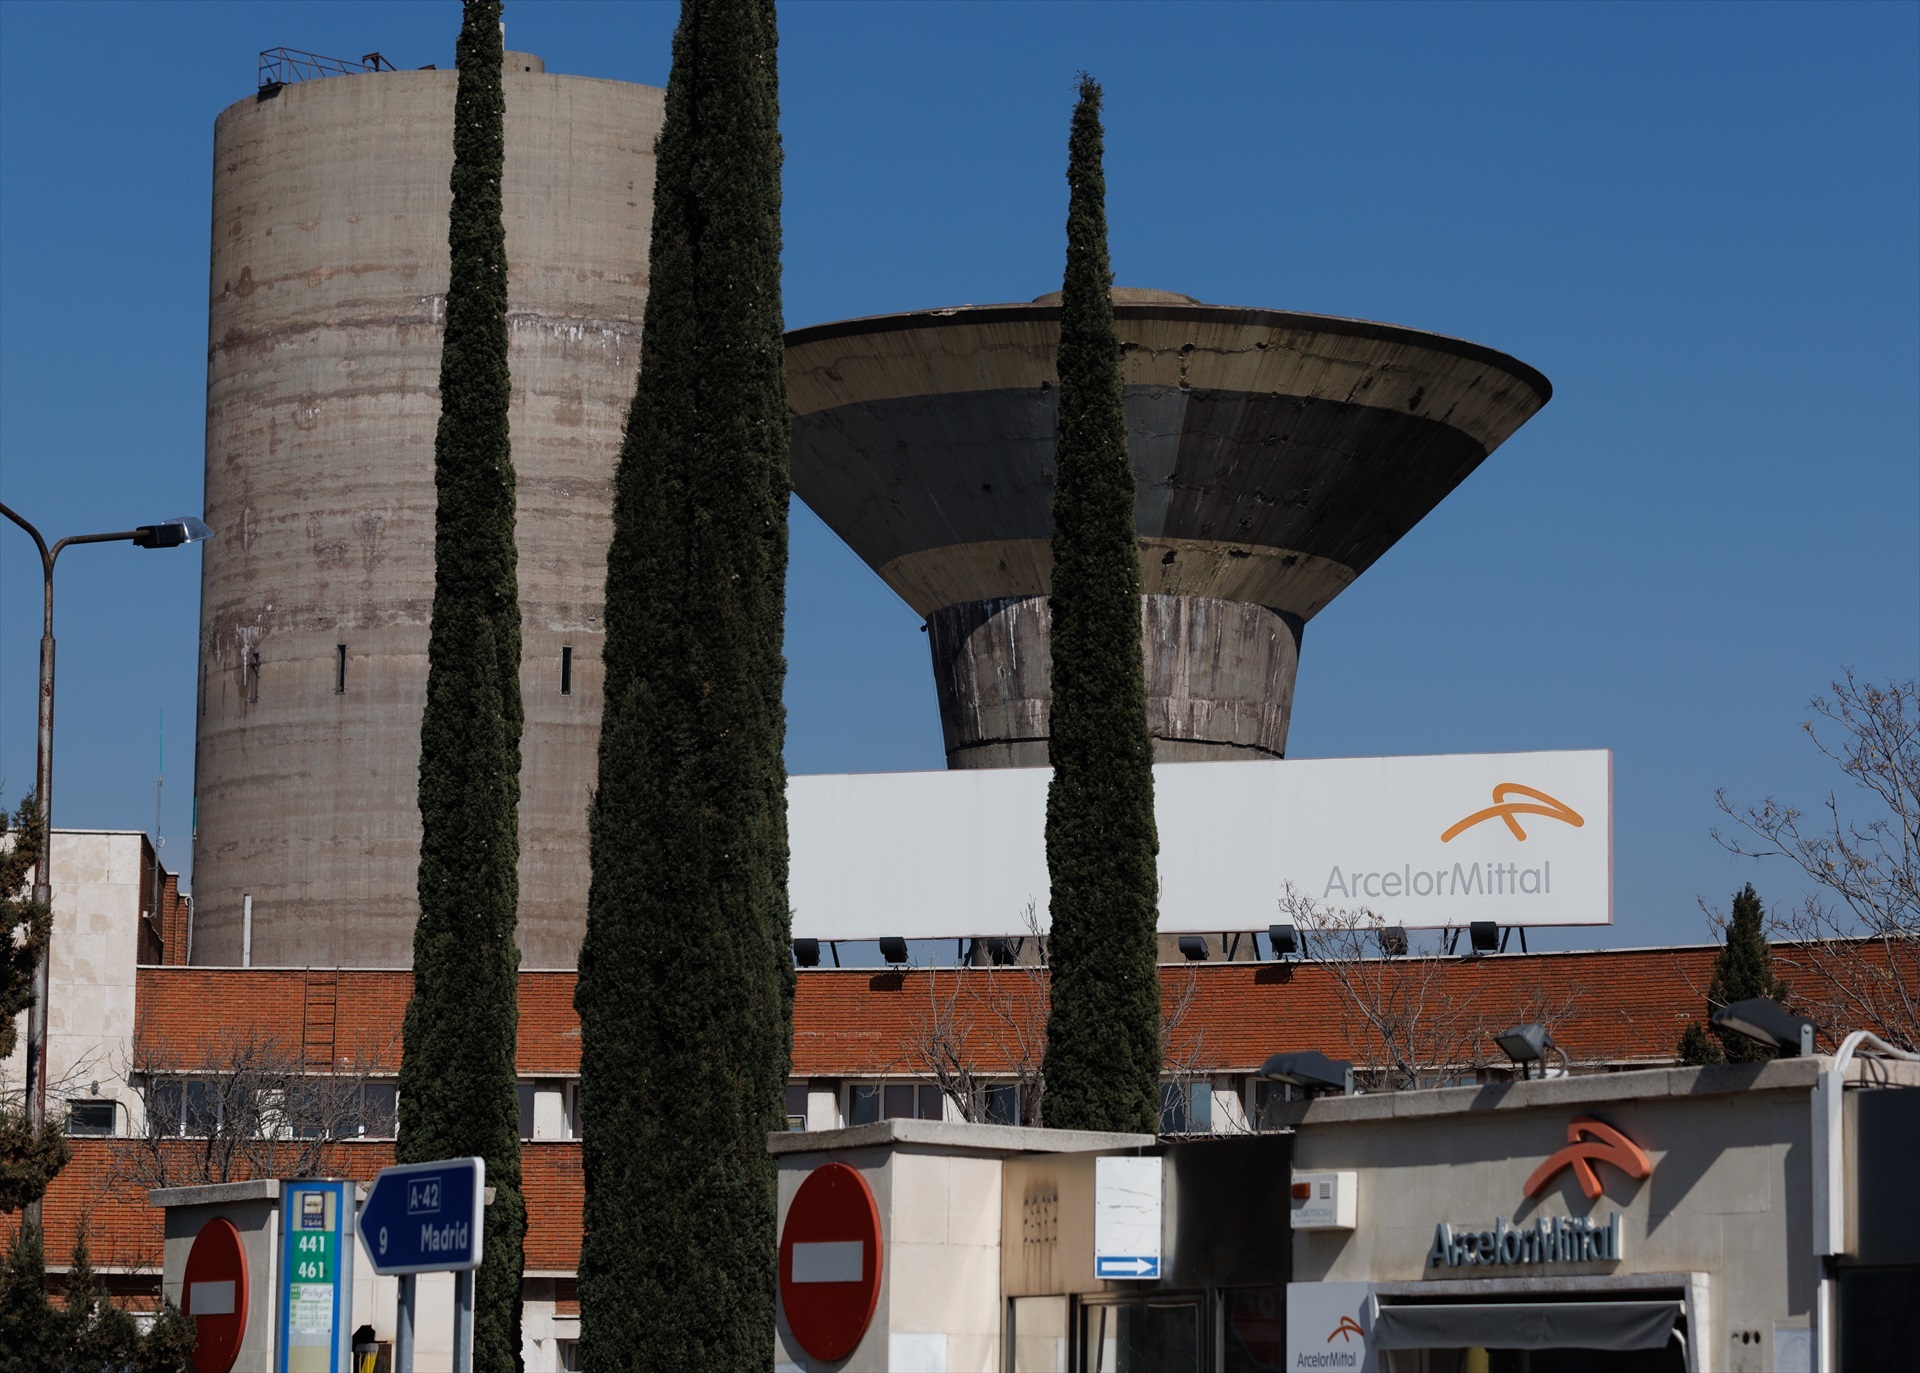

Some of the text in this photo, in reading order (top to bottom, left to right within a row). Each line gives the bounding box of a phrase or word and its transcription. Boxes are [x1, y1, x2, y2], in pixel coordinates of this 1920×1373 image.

[1322, 860, 1551, 898] ArcelorMittal
[298, 1235, 325, 1253] 441
[379, 1221, 468, 1255] 9 Madrid
[1429, 1211, 1621, 1268] ArcelorMittal
[298, 1261, 325, 1279] 461
[1297, 1351, 1356, 1368] ArcelorMittal
